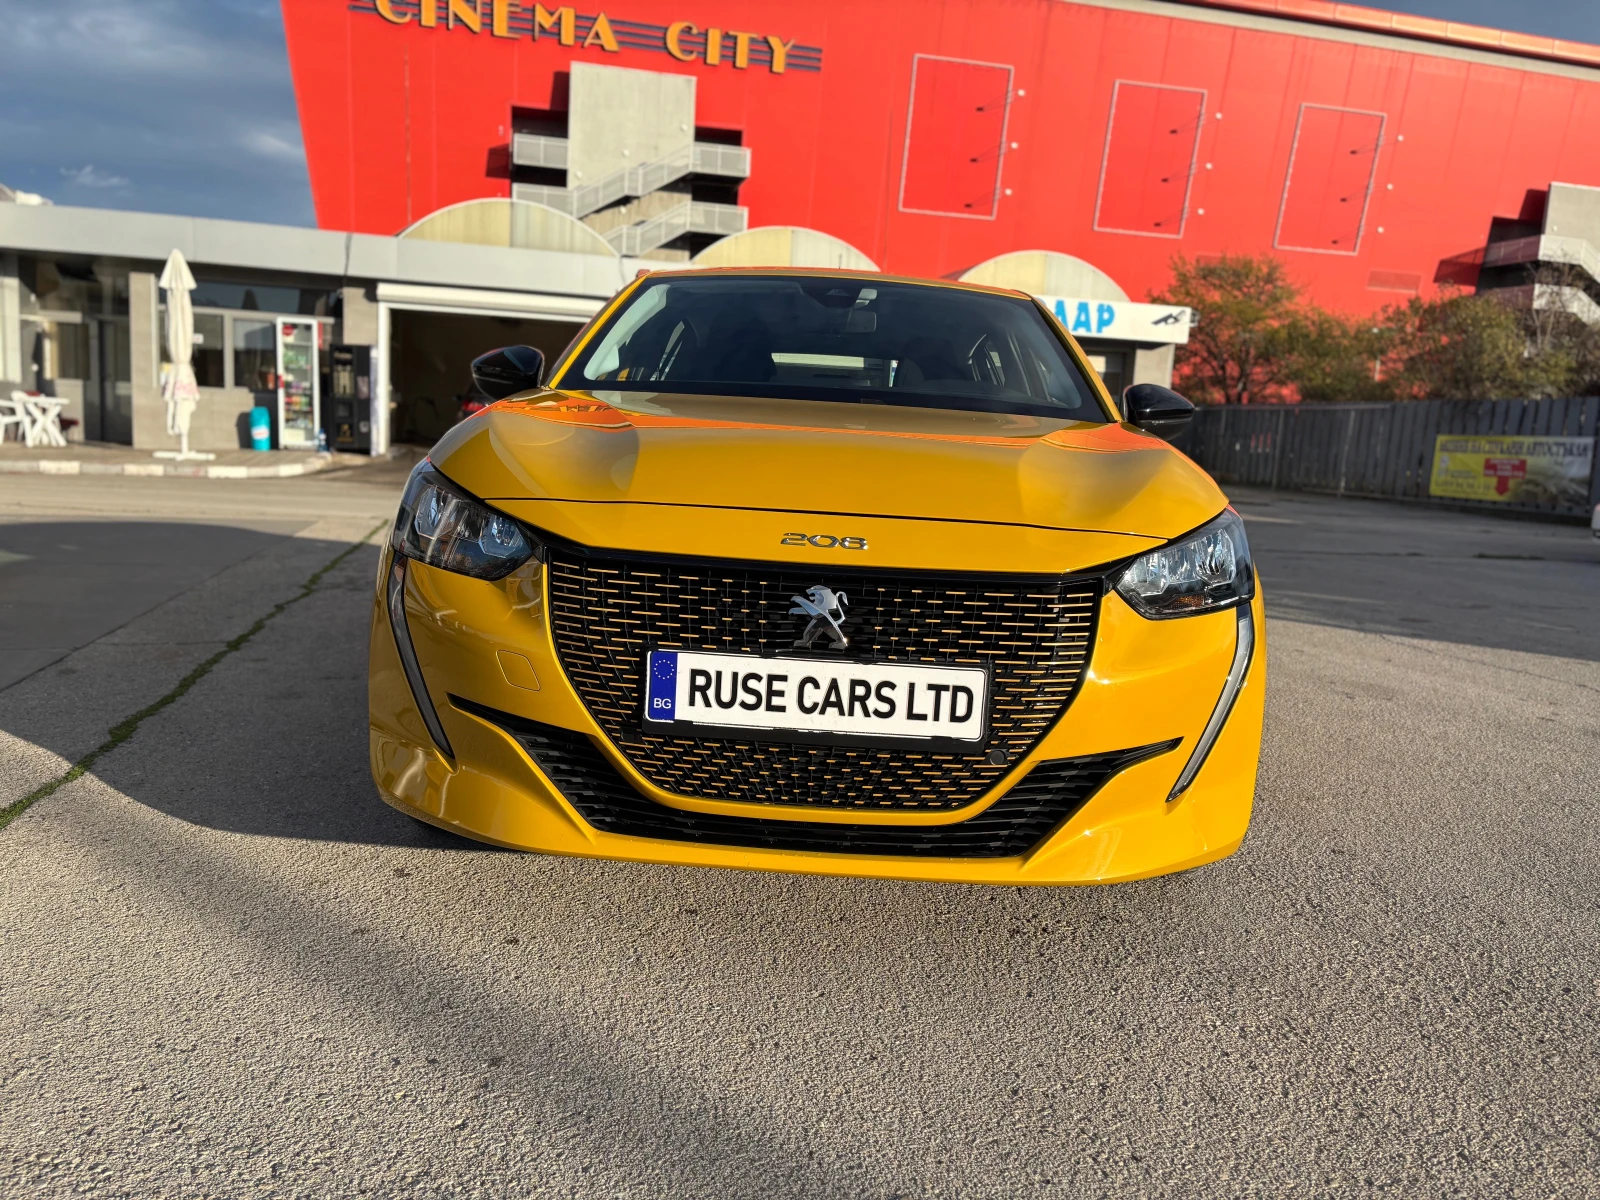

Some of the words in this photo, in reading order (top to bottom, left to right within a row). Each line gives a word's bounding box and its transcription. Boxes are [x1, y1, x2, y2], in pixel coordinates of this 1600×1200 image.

[375, 0, 621, 52] CINEMA
[665, 21, 796, 74] CITY
[780, 532, 869, 550] 208
[653, 697, 672, 710] BG
[688, 668, 788, 713] RUSE
[797, 676, 897, 719] CARS
[906, 682, 974, 723] LTD
